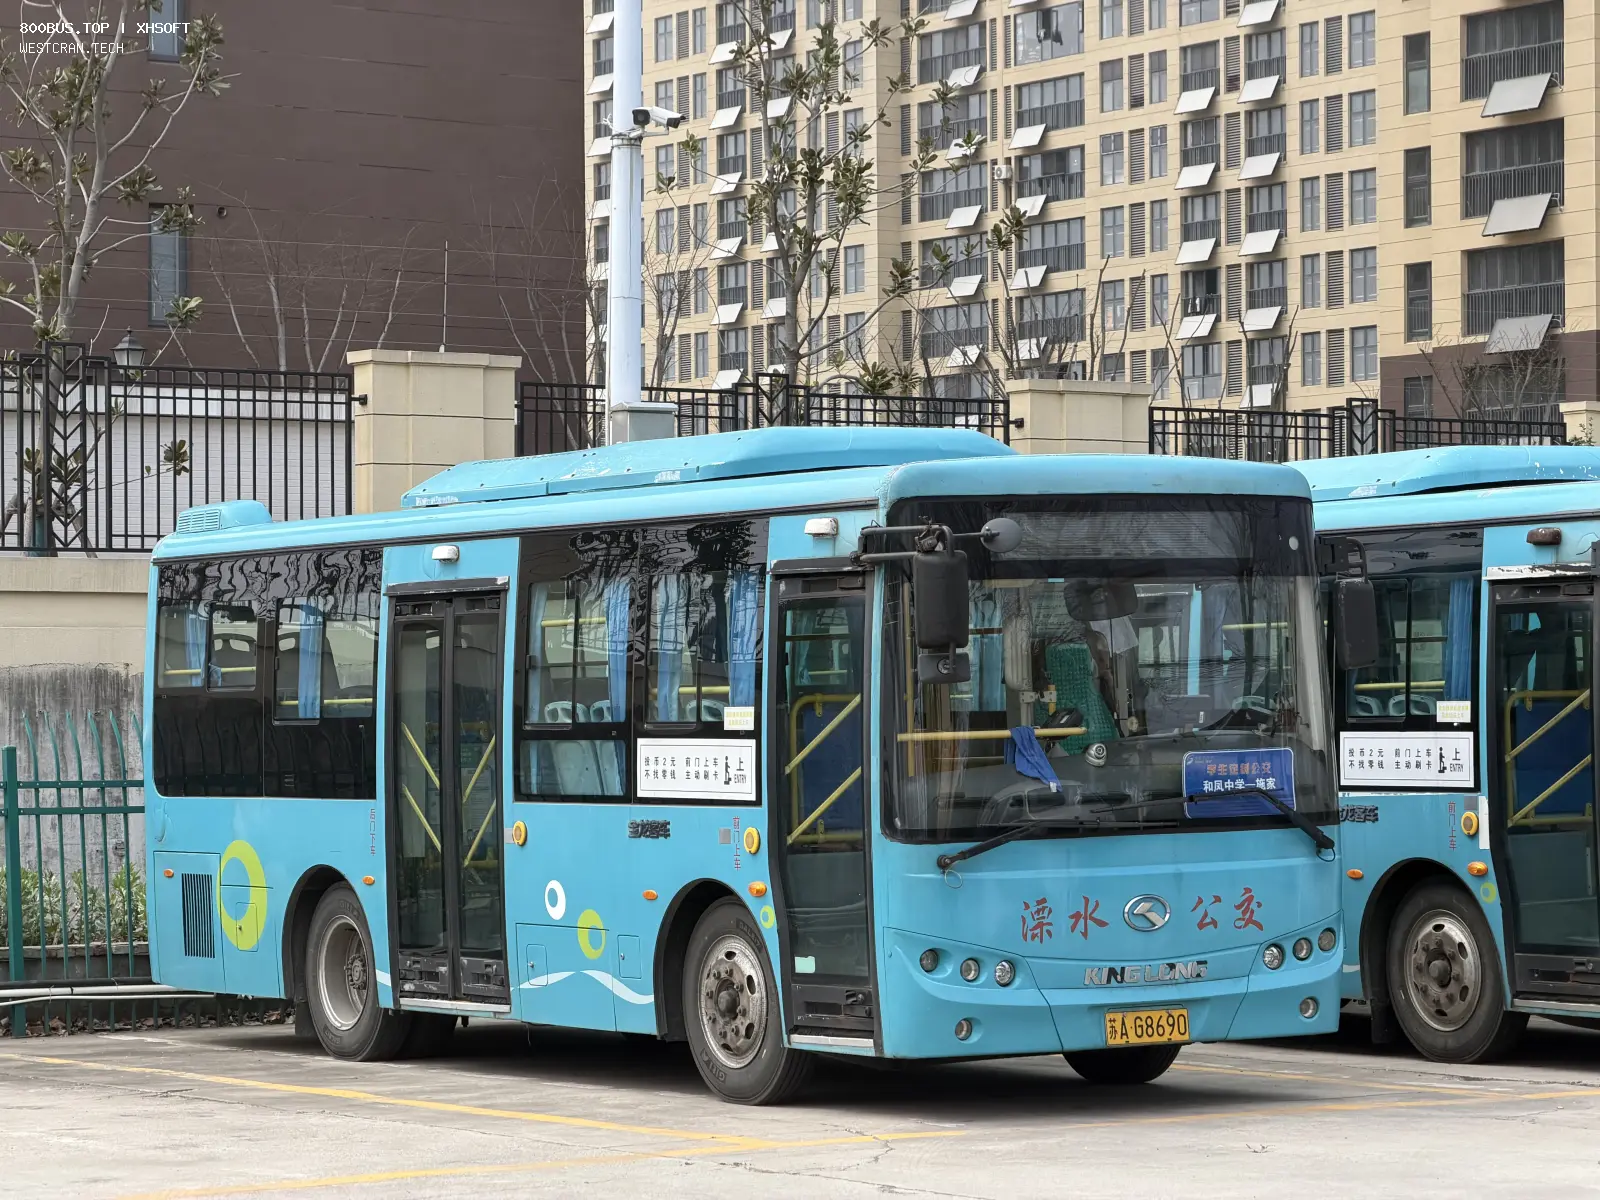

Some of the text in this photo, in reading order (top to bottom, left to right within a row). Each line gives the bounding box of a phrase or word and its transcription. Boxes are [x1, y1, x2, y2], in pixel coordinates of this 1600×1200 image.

[1348, 748, 1432, 758] 投币2元 前门上车
[1452, 748, 1461, 761] 上
[644, 756, 719, 767] 投币2元 前门上车
[736, 756, 745, 771] 上
[1348, 759, 1432, 770] 不找零钱 主动刷卡
[1449, 763, 1464, 773] ENTRY
[644, 769, 719, 781] 不找零钱 主动刷卡
[734, 773, 747, 784] ENTRY
[1447, 800, 1457, 851] 前门上车
[732, 816, 742, 871] 前门上车
[1021, 886, 1264, 944] 溧水 公交
